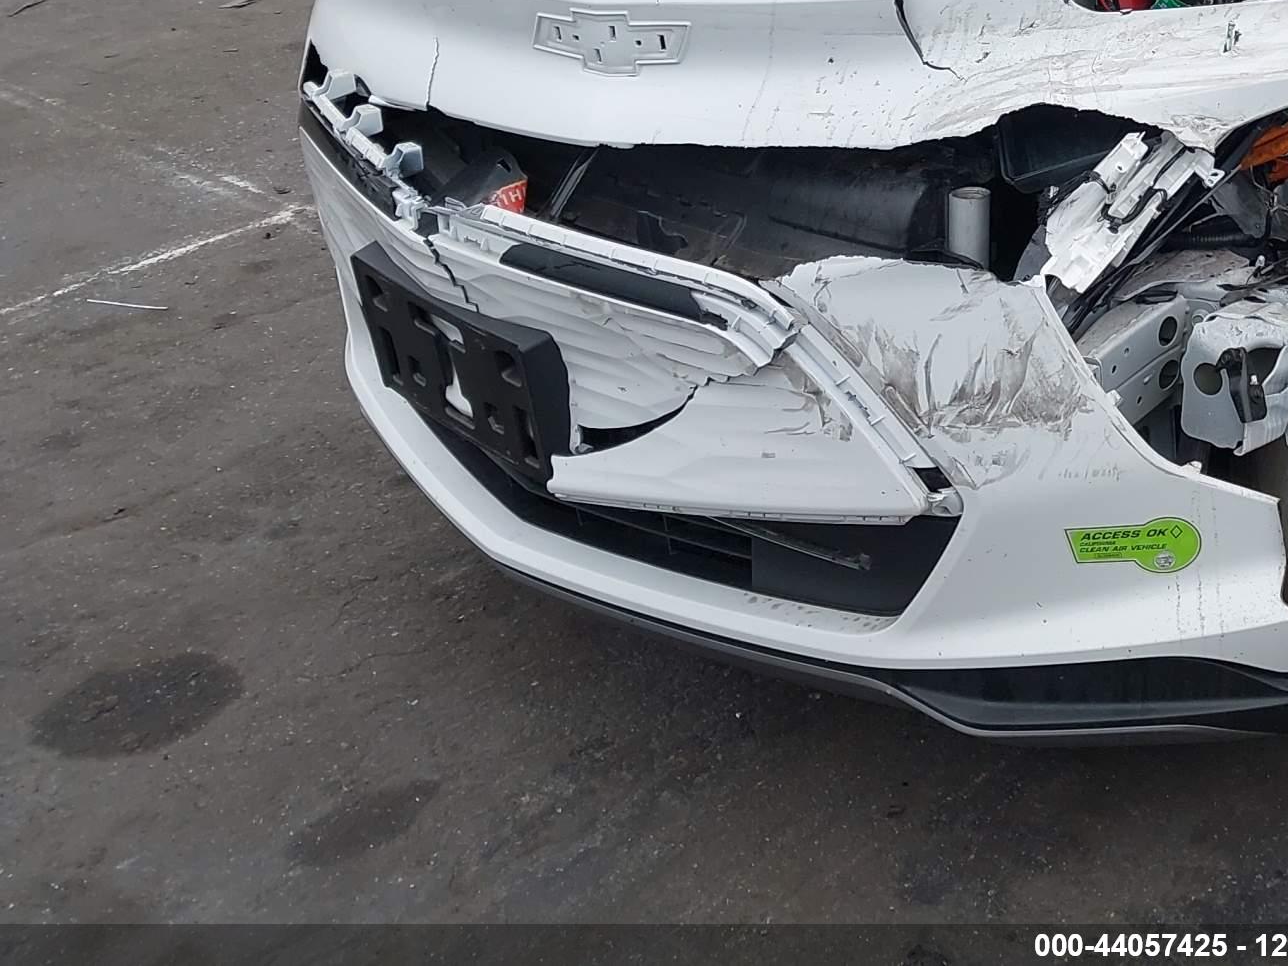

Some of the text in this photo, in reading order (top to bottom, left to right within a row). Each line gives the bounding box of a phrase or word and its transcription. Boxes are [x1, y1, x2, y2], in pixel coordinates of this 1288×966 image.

[1081, 528, 1169, 541] ACCESS OK
[1079, 545, 1110, 553] CLEAN
[1131, 543, 1168, 551] VEHICLE
